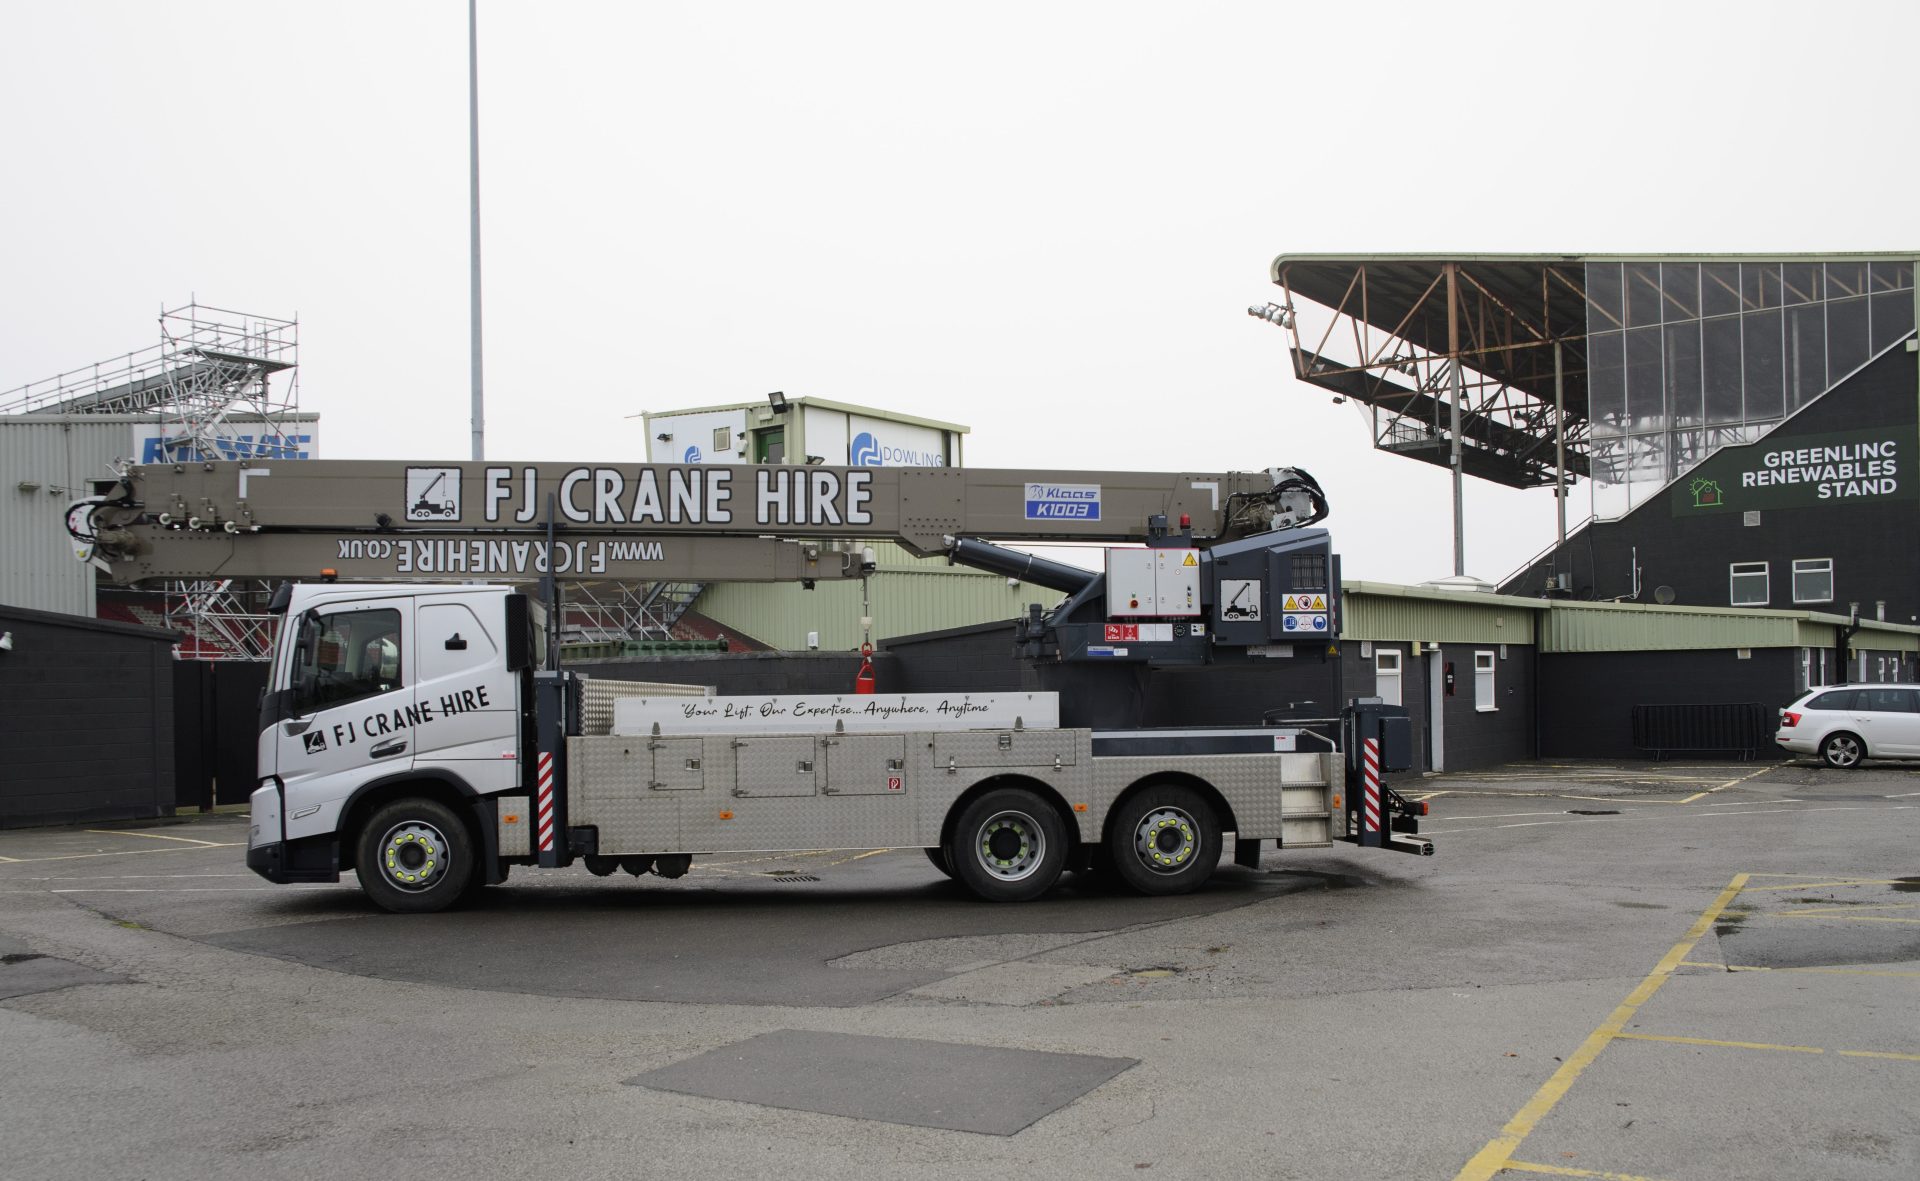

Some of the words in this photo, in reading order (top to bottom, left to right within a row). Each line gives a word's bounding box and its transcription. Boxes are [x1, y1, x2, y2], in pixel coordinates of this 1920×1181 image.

[883, 446, 943, 468] DOWLING
[1763, 440, 1897, 468] GREENLINC
[1742, 459, 1897, 488] RENEWABLES
[484, 466, 538, 523] FJ
[559, 467, 733, 524] CRANE
[756, 469, 873, 526] HIRE
[1046, 487, 1097, 499] Klaas
[1817, 478, 1897, 499] STAND
[1036, 503, 1090, 517] K1003
[333, 721, 356, 747] FJ
[363, 700, 434, 738] CRANE
[440, 685, 490, 718] HIRE
[759, 702, 787, 718] Our
